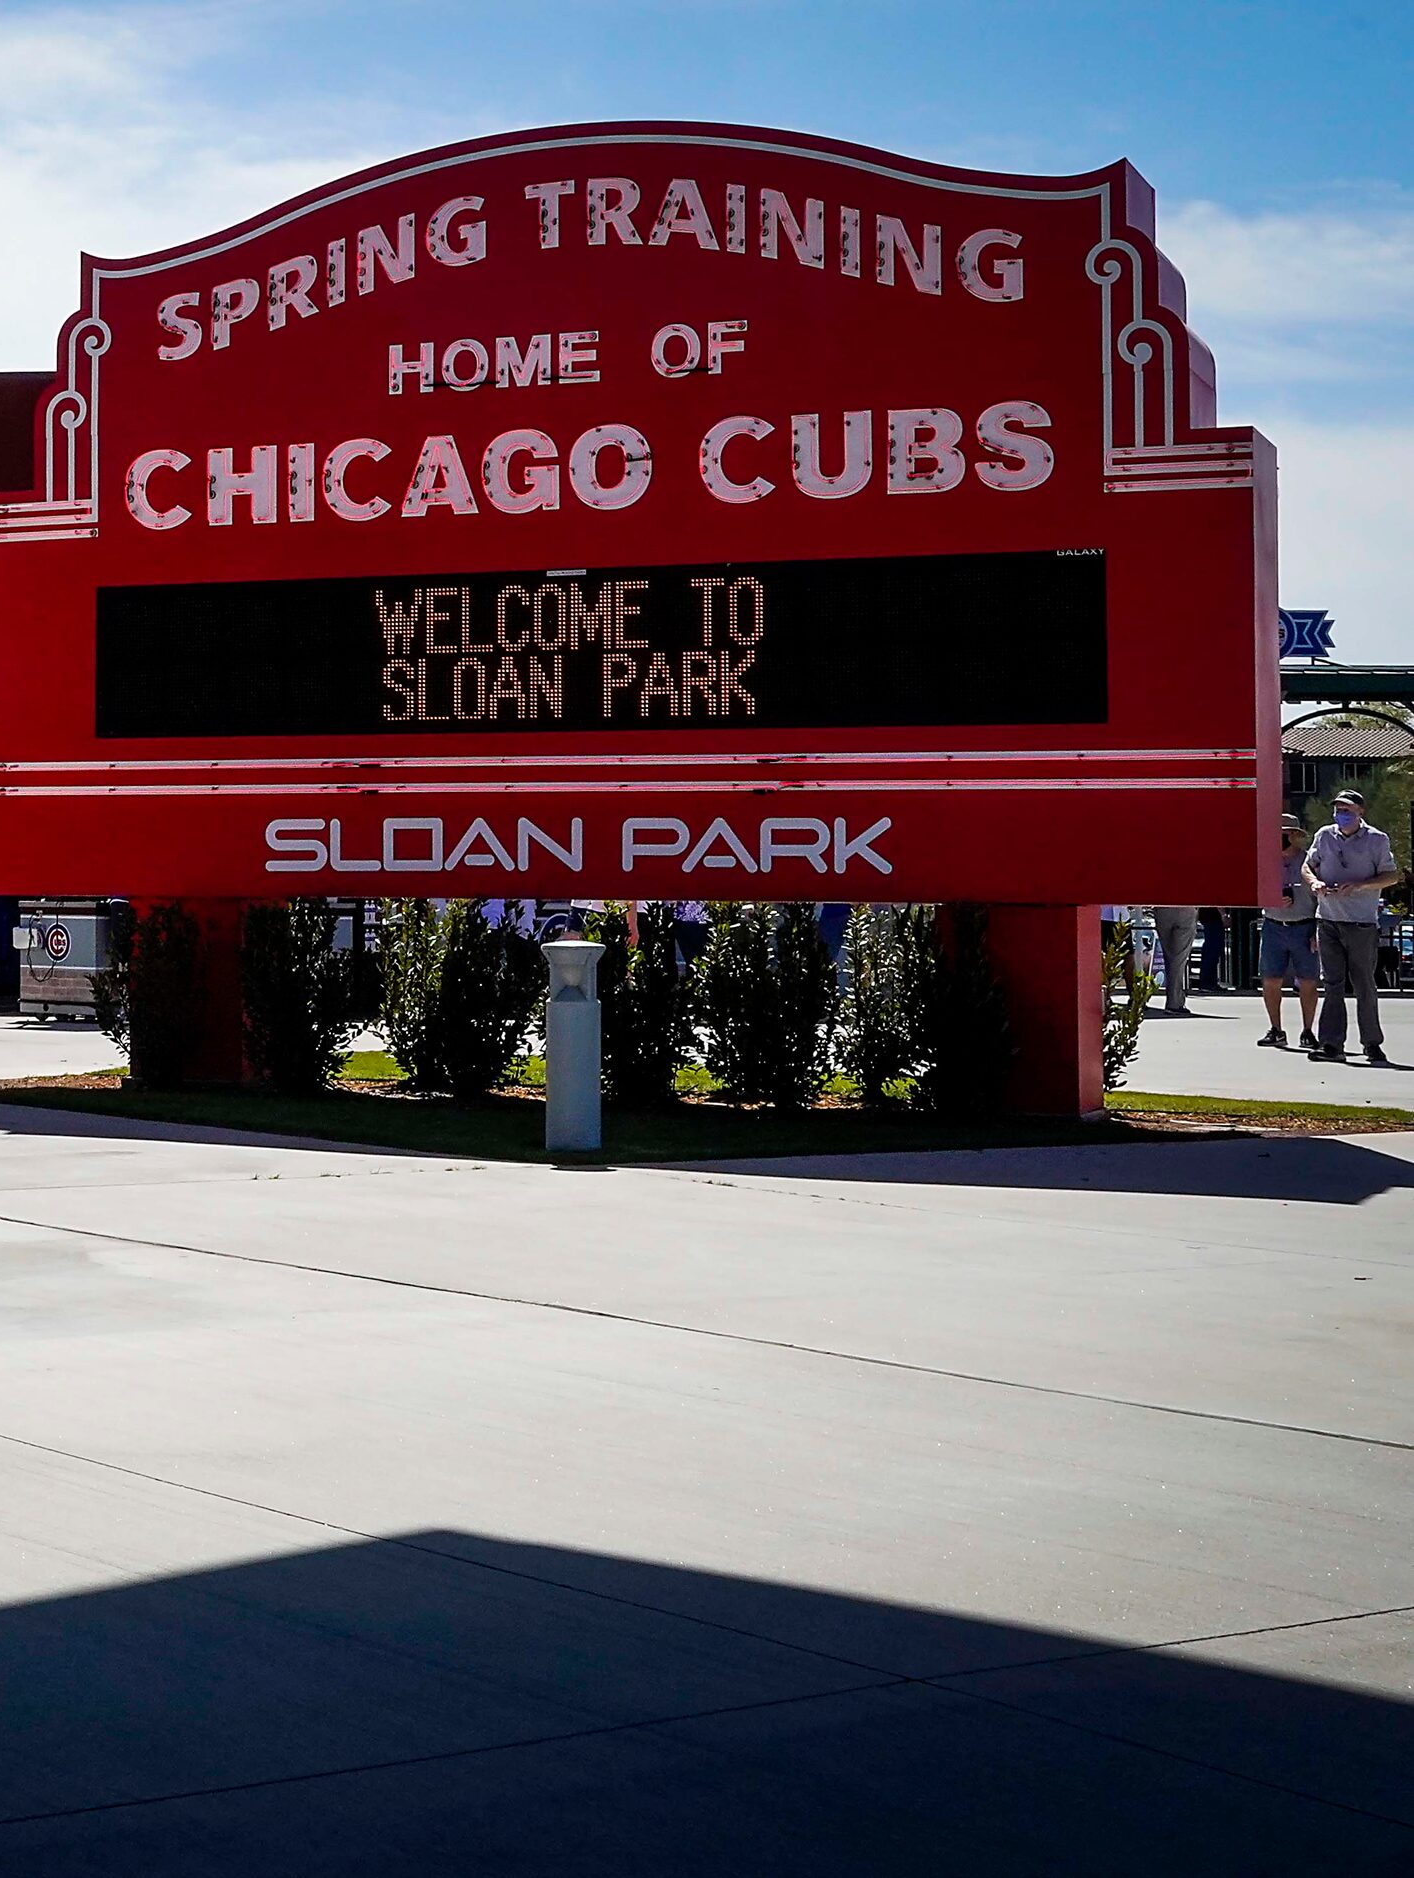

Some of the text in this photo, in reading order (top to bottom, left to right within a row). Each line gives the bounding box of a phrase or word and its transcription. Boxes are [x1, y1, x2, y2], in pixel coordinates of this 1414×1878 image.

[158, 177, 1024, 361] SPRING TRAINING
[388, 319, 748, 396] HOME OF
[125, 400, 1055, 531] CHICAGO CUBS
[1056, 548, 1104, 557] GALAXY
[375, 576, 764, 655] WELCOME TO
[383, 650, 756, 720] SLOAN PARK
[265, 816, 893, 875] SLOAN PARK
